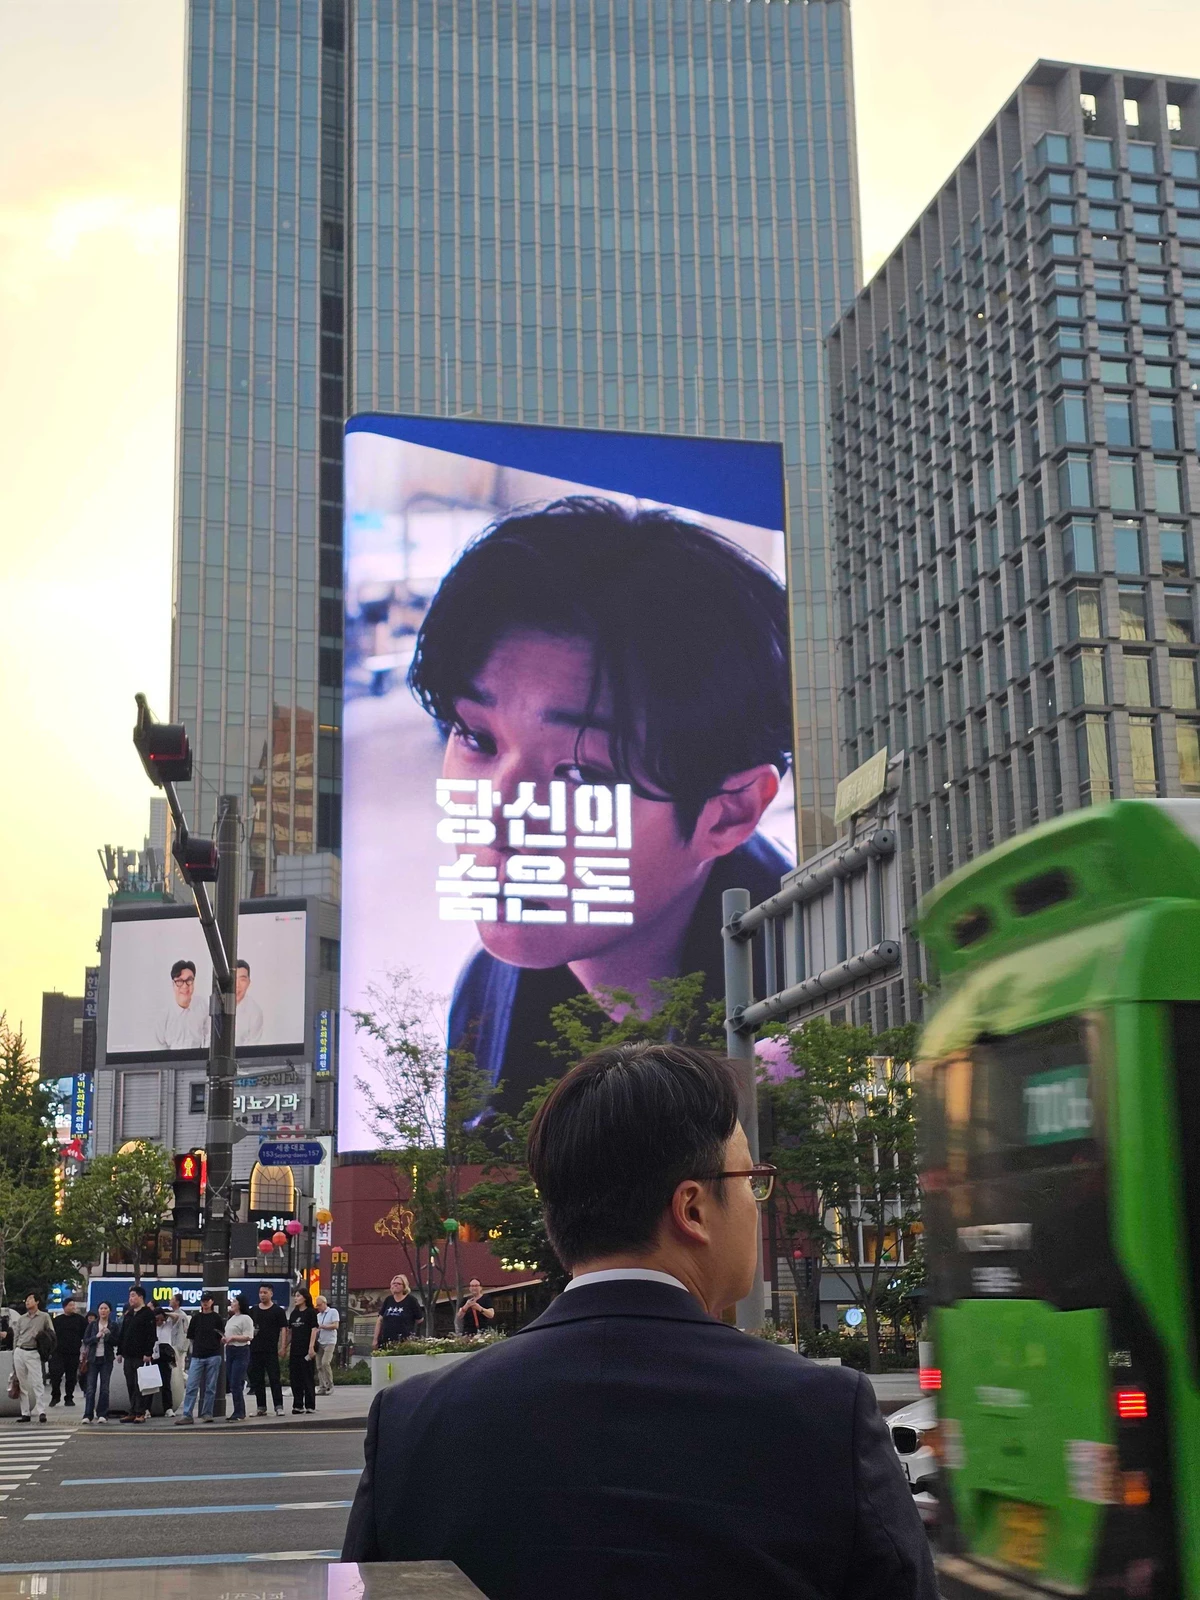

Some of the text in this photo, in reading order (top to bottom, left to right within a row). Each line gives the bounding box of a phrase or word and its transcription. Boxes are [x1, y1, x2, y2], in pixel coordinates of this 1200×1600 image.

[436, 778, 632, 849] 당신의
[251, 1112, 295, 1126] 피부과
[262, 1150, 274, 1158] 153
[275, 1143, 306, 1153] 세종대로
